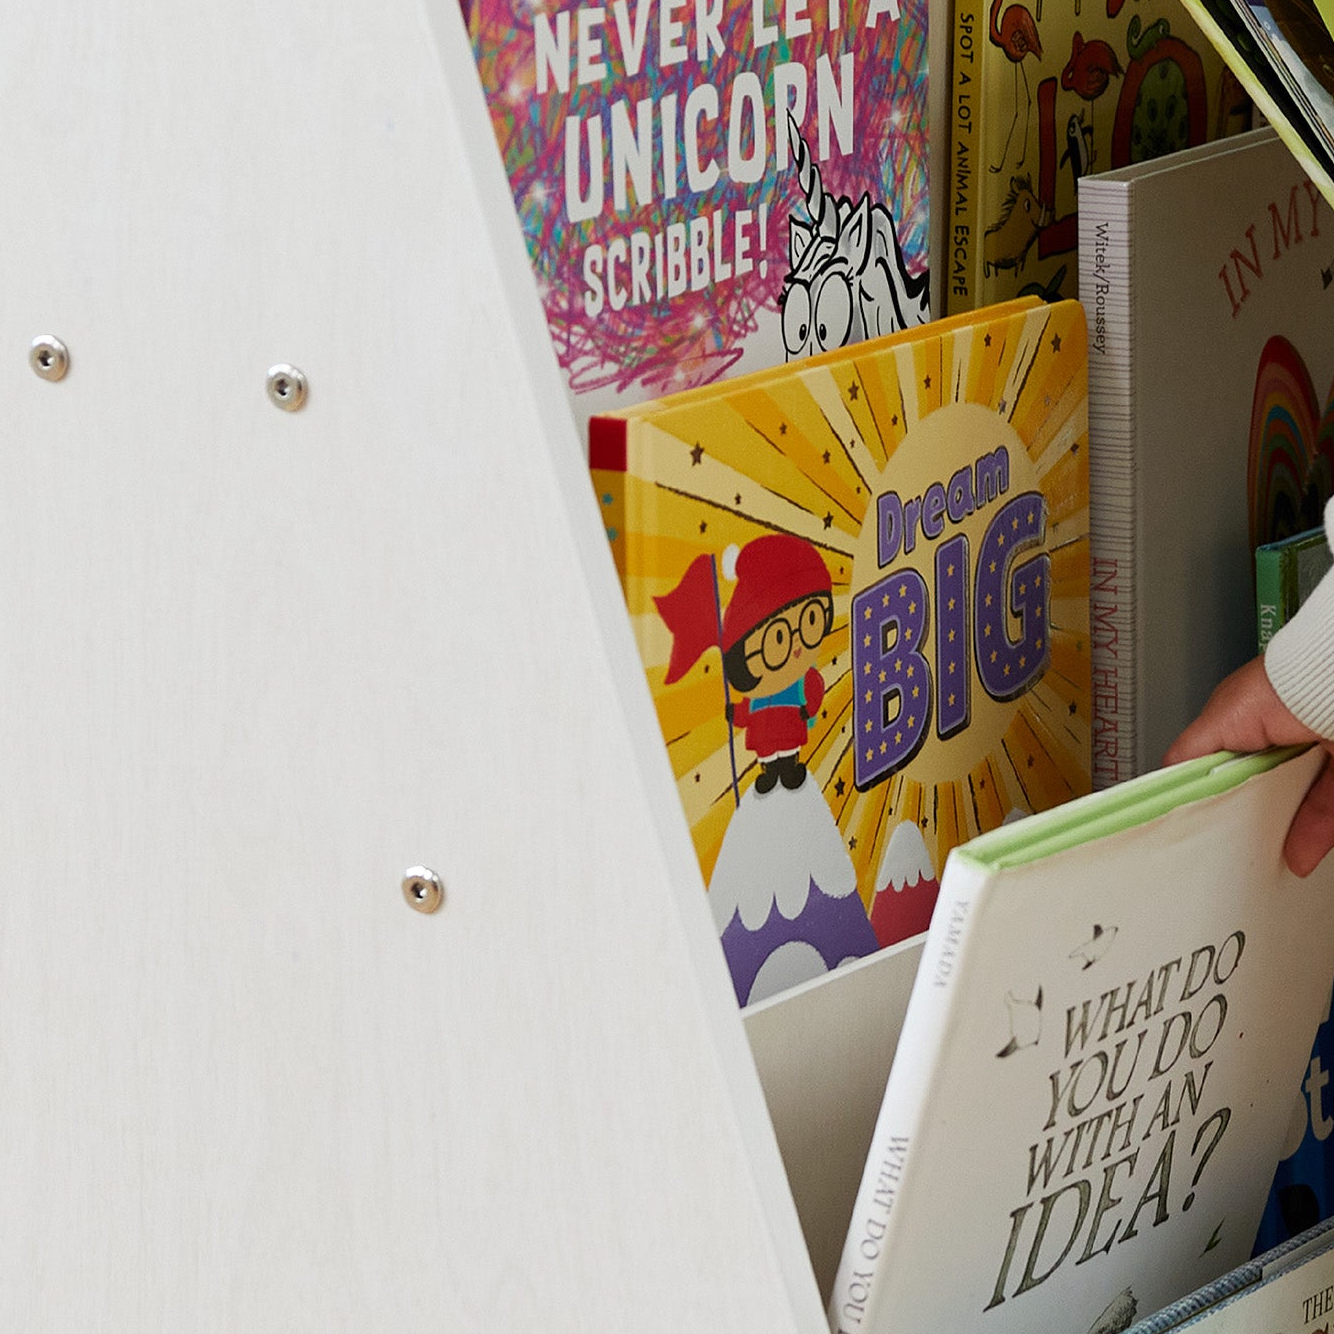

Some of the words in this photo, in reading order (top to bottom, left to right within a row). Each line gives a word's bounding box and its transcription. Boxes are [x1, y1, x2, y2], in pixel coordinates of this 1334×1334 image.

[959, 13, 974, 64] SPOT
[959, 71, 972, 86] A
[566, 53, 855, 223] UNICORN
[956, 93, 972, 135] LOT
[954, 142, 971, 216] ANIMAL
[583, 202, 769, 317] SCRIBBLE!
[952, 224, 970, 297] ESCAPE
[1094, 222, 1109, 355] Witek/Roussey
[1219, 224, 1263, 317] IN
[877, 445, 1010, 569] Dream
[1091, 557, 1118, 596] IN
[851, 491, 1052, 793] BIG
[1093, 603, 1118, 660] MY
[1093, 666, 1119, 782] HEART
[934, 901, 969, 989] YAMADA
[1065, 958, 1182, 1058] WHAT
[1179, 930, 1246, 1002] DO
[1042, 1029, 1148, 1132] YOU
[1147, 993, 1228, 1081] DO
[1026, 1093, 1144, 1196] WITH
[1142, 1060, 1213, 1141] AN
[873, 1135, 909, 1214] WHAT
[983, 1107, 1231, 1313] IDEA?
[860, 1219, 887, 1260] DO
[843, 1272, 874, 1324] YOU
[1302, 1288, 1334, 1324] THE
